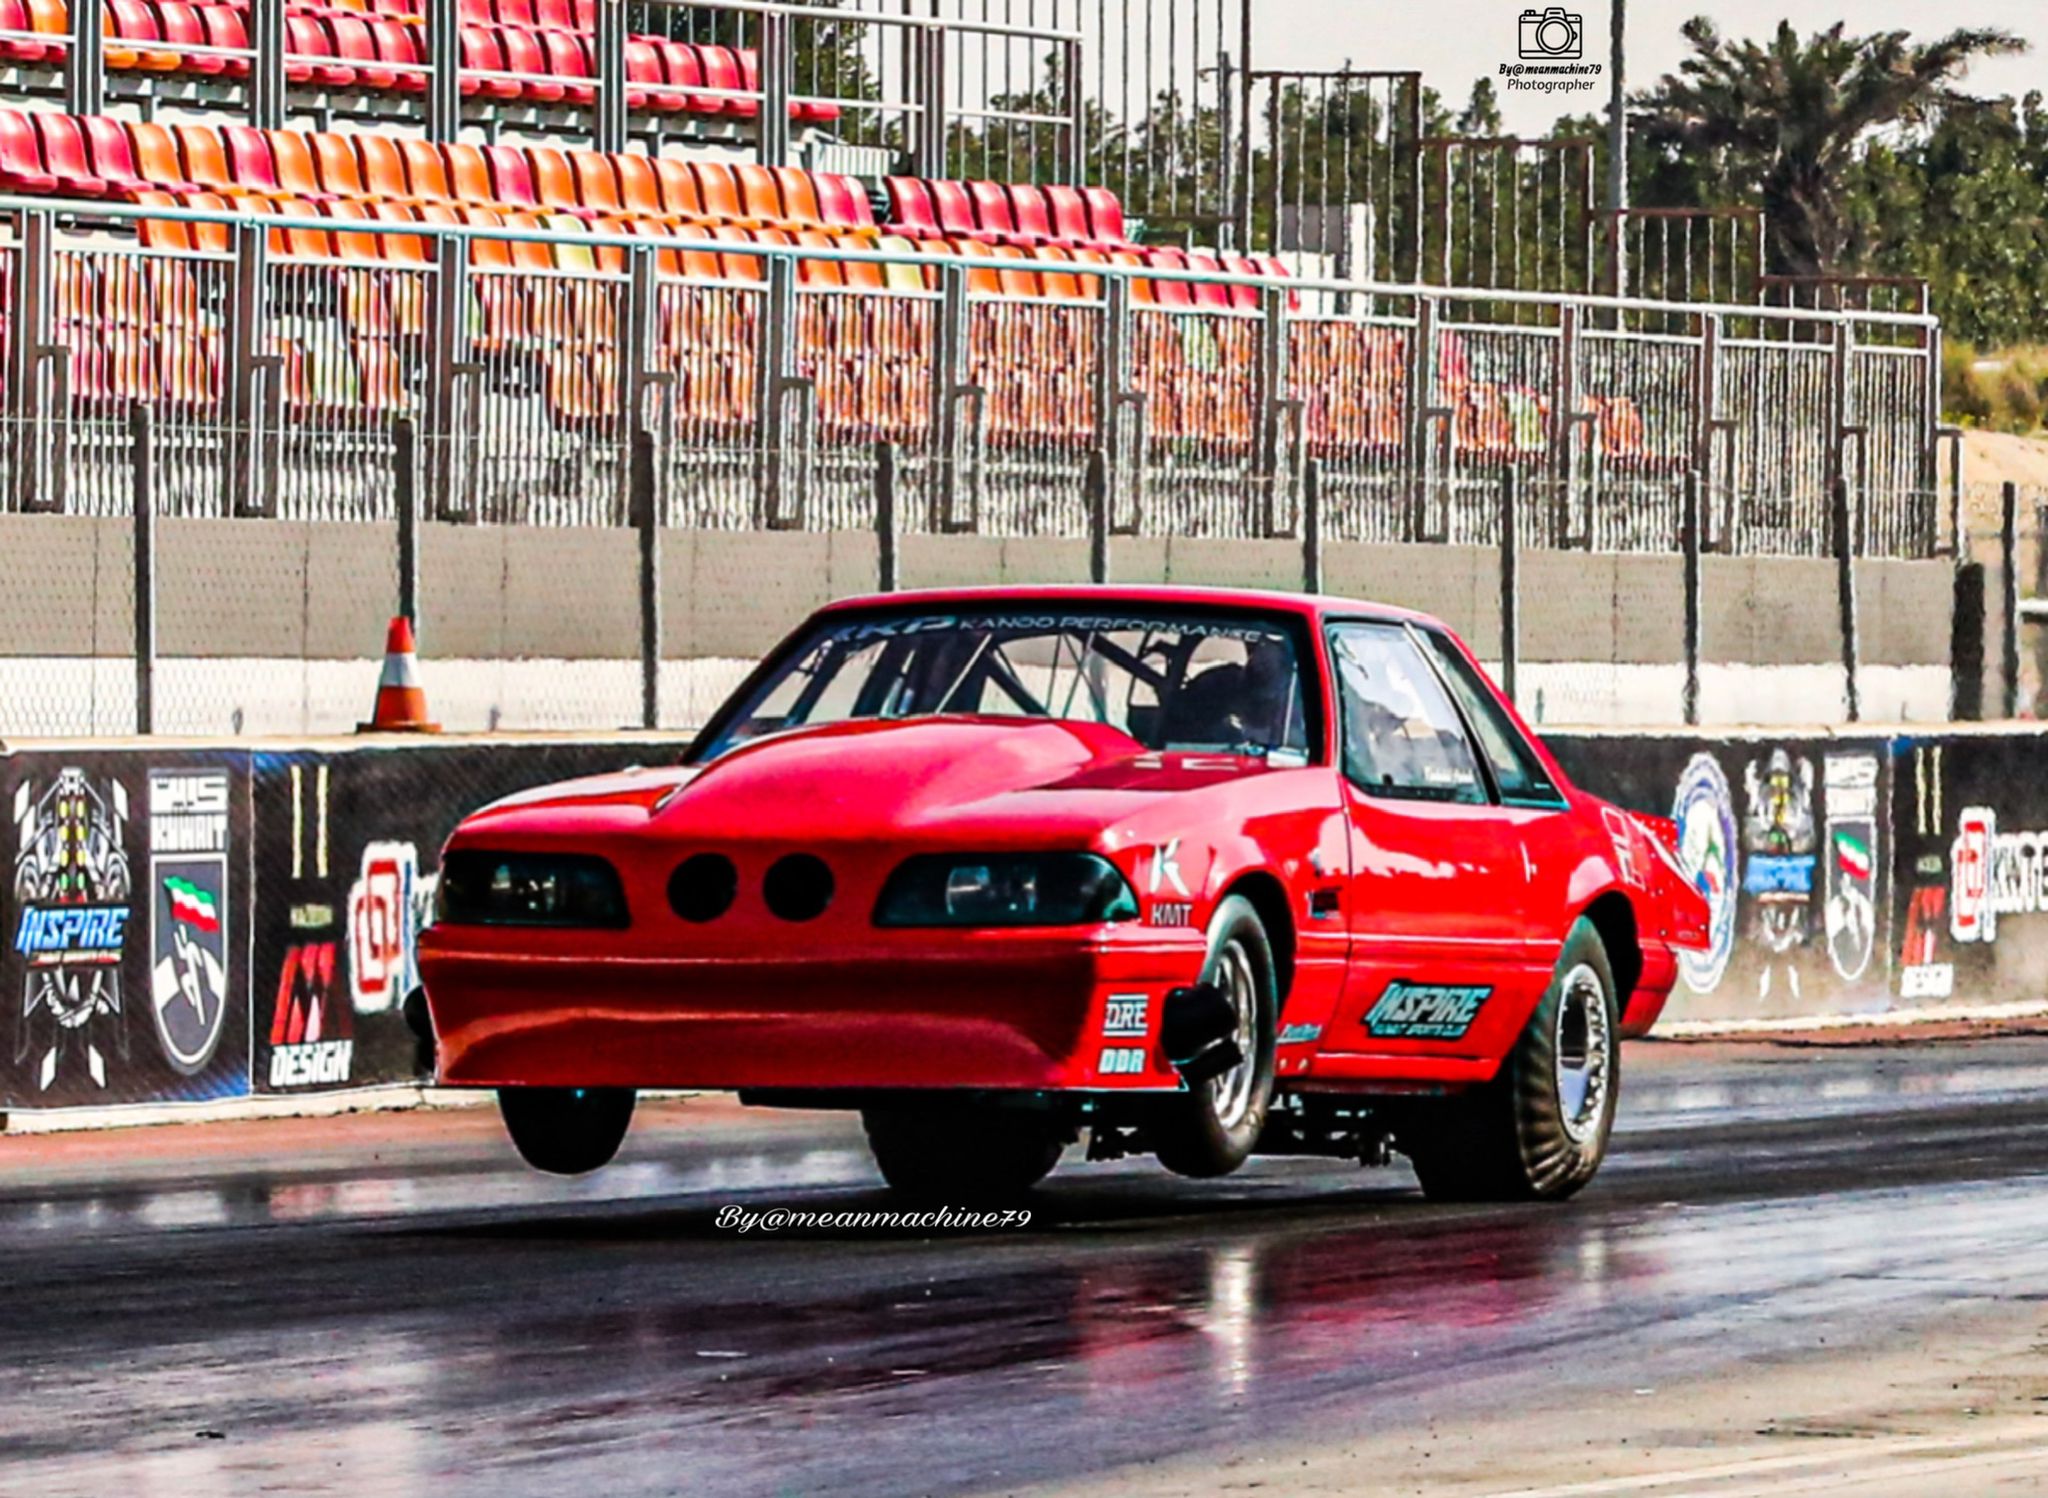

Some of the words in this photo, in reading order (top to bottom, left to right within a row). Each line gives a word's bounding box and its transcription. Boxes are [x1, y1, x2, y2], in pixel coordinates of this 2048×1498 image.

[15, 905, 130, 957] INSPIRE
[1152, 904, 1193, 927] KMT
[1365, 983, 1492, 1027] INSPIRE
[270, 1039, 353, 1086] DESIGN
